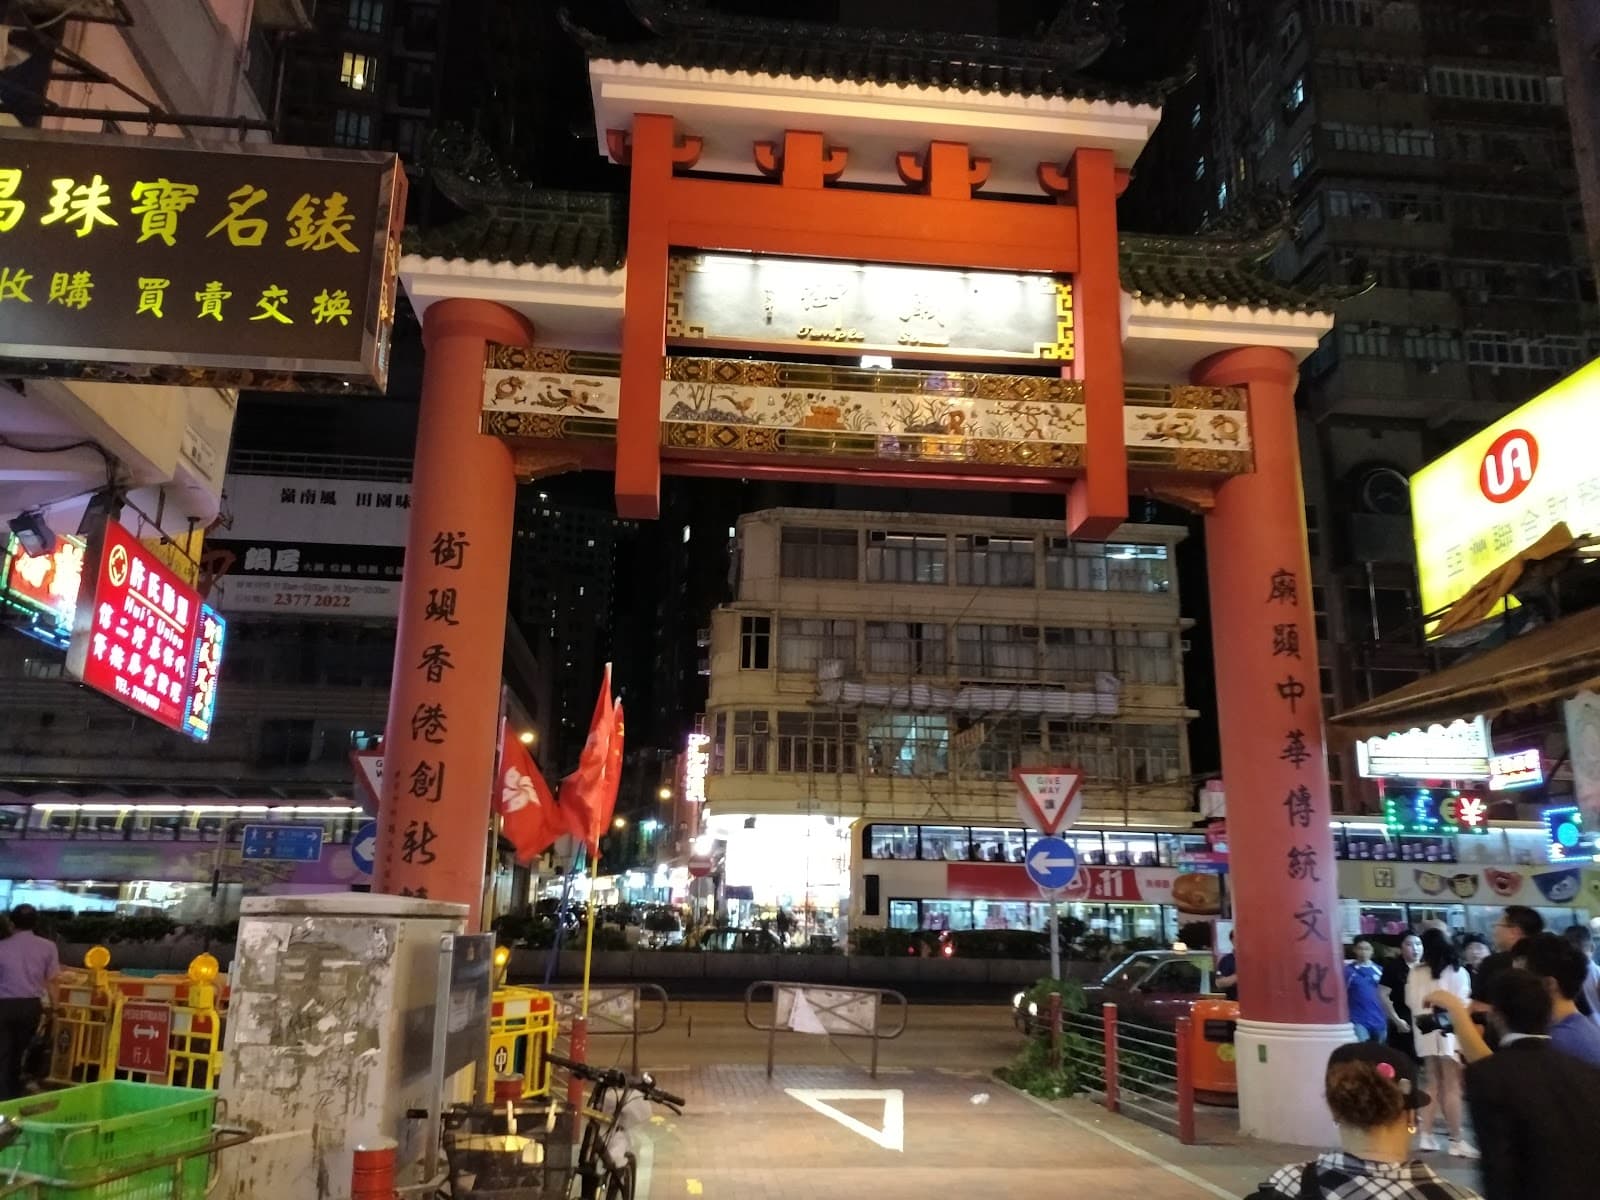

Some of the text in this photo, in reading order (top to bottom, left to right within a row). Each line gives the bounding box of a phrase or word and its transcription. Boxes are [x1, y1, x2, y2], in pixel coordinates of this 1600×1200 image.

[0, 267, 95, 310] 收購
[136, 276, 353, 326] 買賣交換
[273, 593, 311, 606] 2377
[314, 594, 351, 608] 2022
[1038, 786, 1061, 795] WAY
